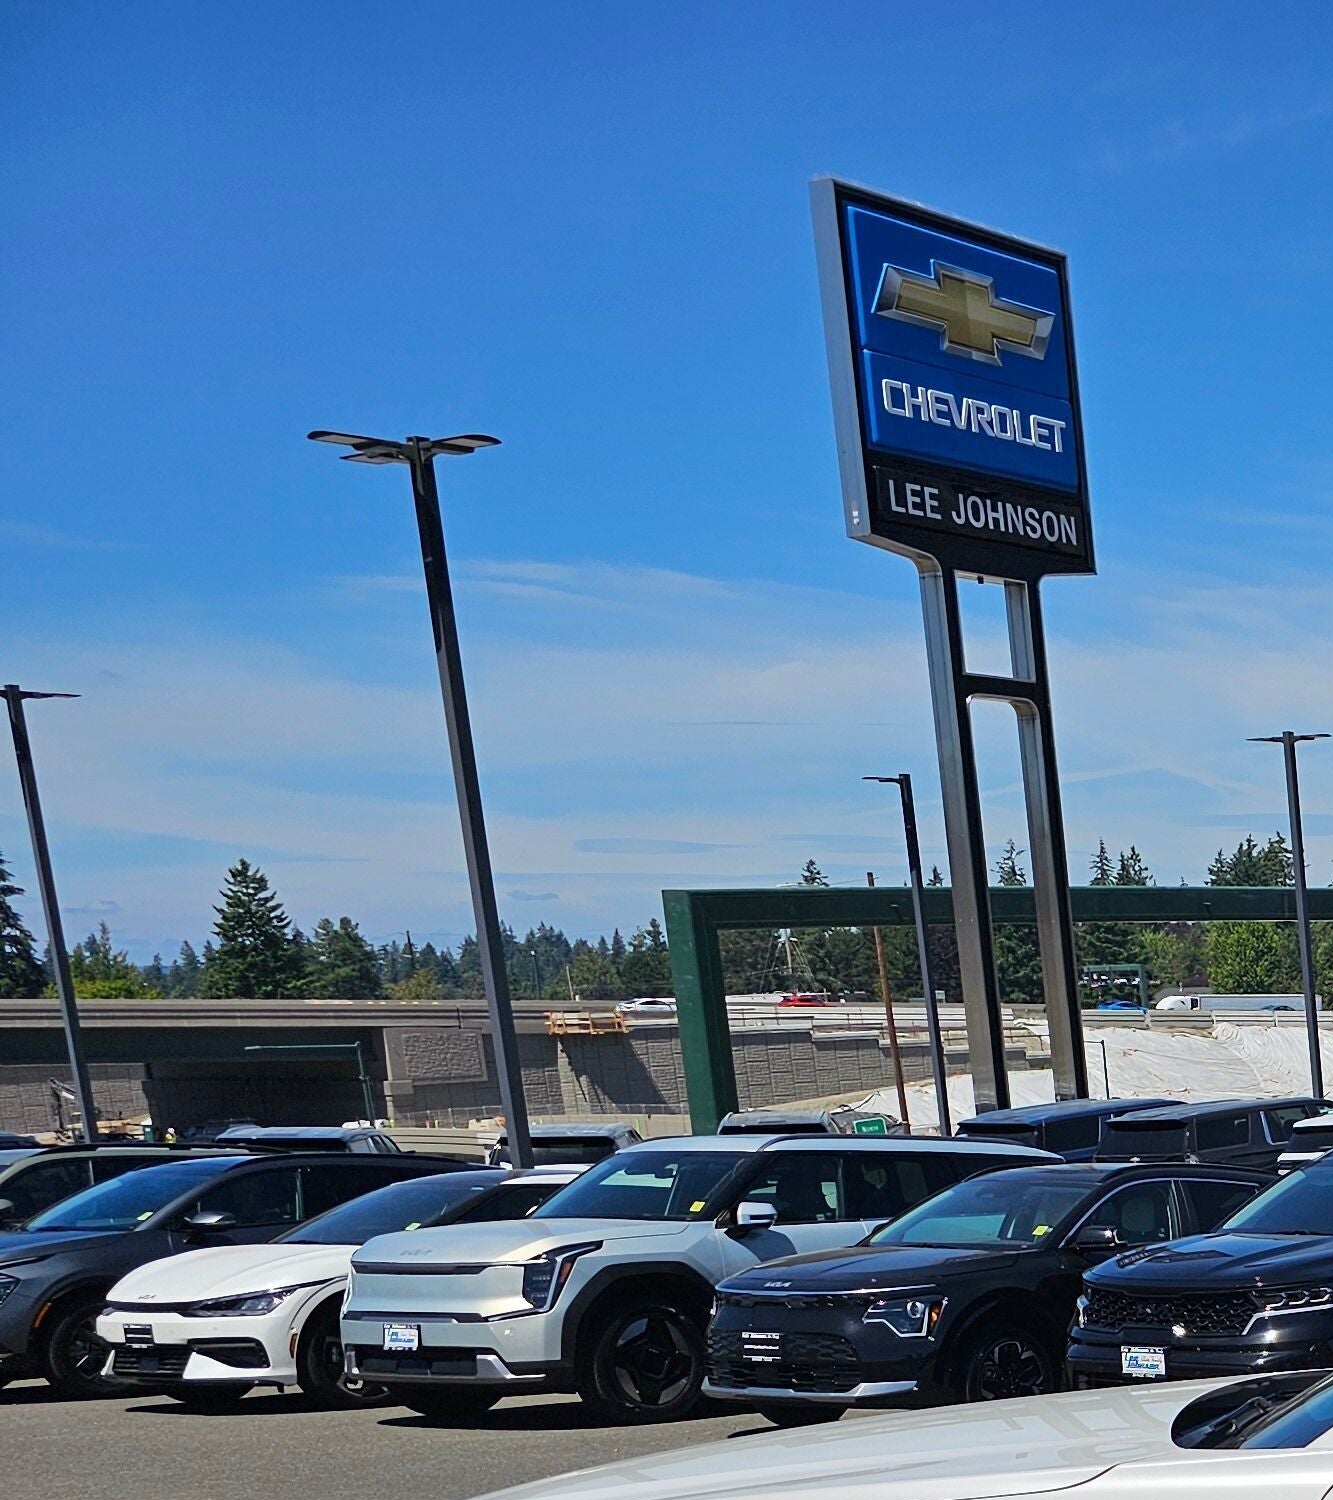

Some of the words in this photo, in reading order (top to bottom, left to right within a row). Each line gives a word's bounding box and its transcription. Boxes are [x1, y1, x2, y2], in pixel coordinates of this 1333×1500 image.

[881, 378, 1066, 453] CHEVROLET
[888, 478, 942, 520] LEE
[951, 492, 1078, 546] JOHNSON
